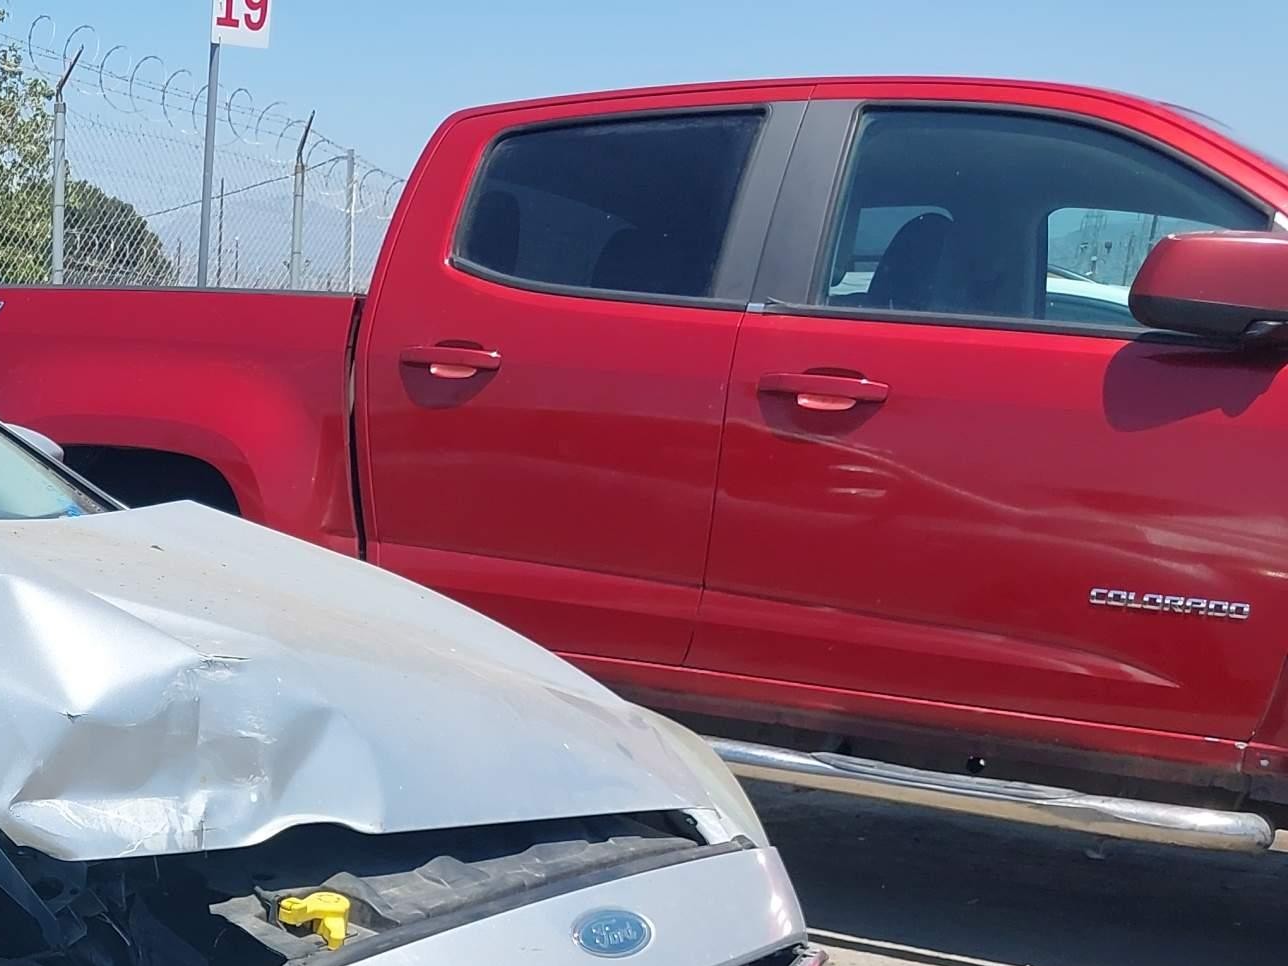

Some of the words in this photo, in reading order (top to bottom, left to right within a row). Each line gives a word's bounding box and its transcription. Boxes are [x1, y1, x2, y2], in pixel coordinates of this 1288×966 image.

[216, 0, 269, 31] 19
[1089, 587, 1250, 620] COLORADO
[589, 917, 637, 948] Ford
